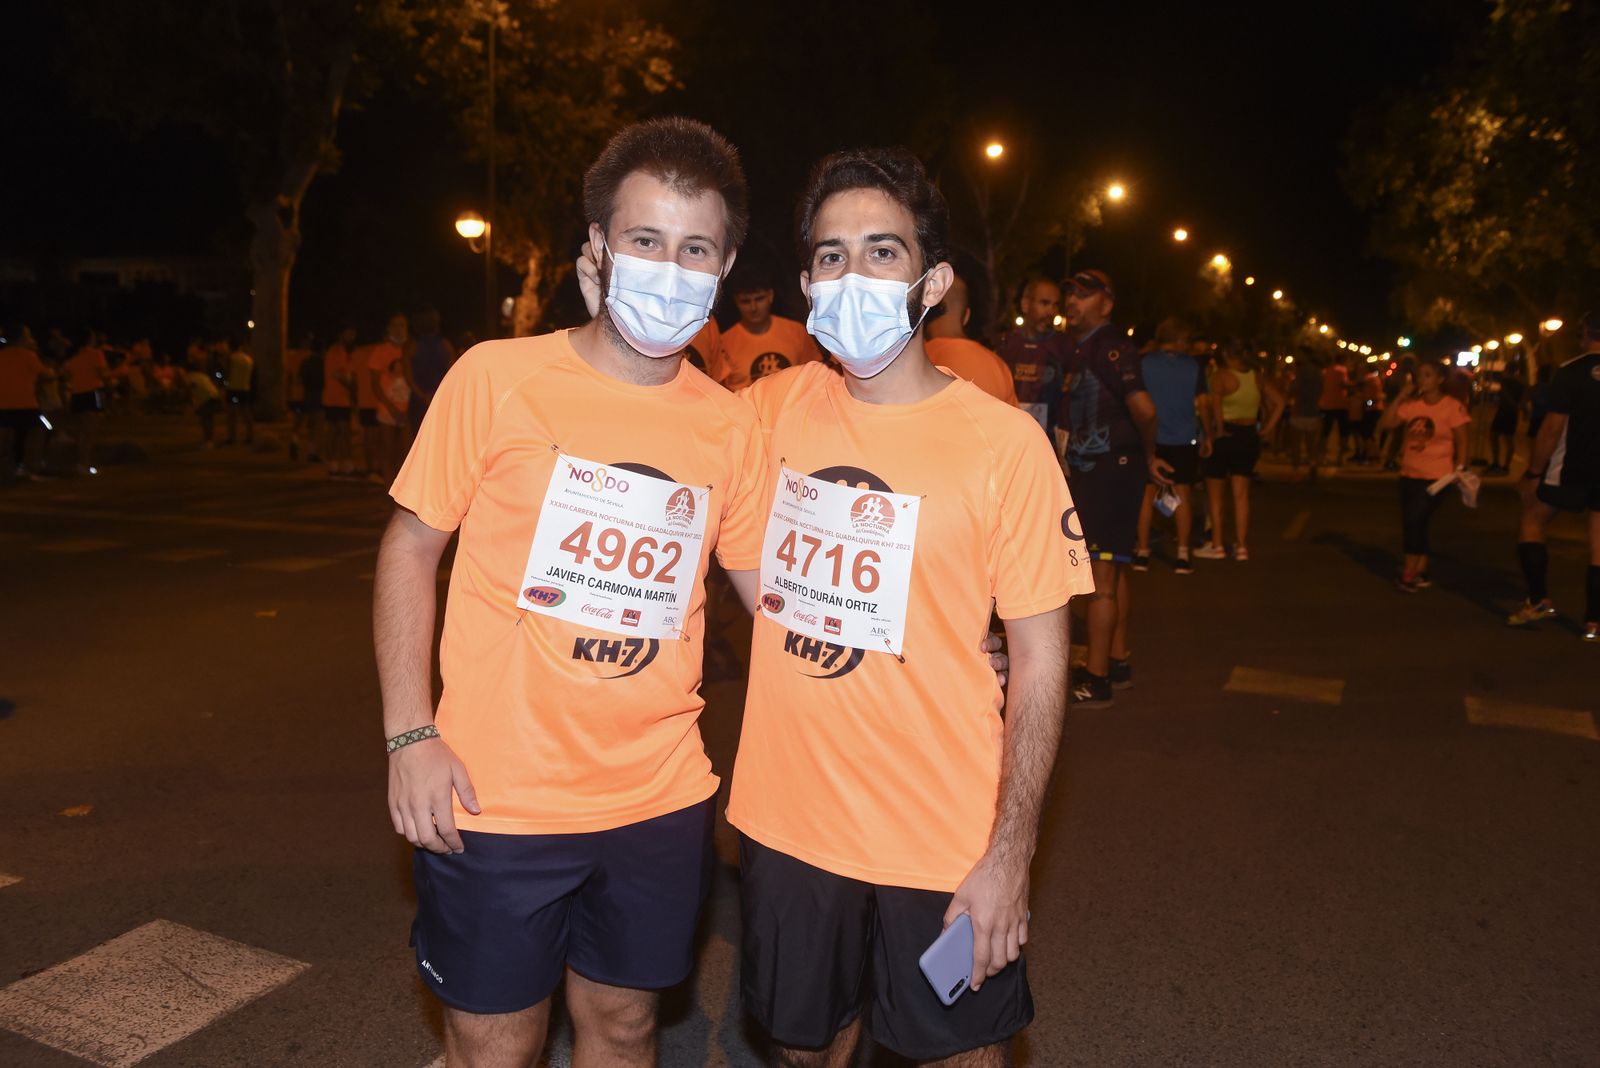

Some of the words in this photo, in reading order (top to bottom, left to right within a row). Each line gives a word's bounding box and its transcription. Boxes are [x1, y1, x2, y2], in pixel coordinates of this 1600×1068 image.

[549, 499, 569, 510] XXXIII
[568, 504, 598, 519] CARRERA
[598, 513, 635, 528] NOCTURNA
[635, 523, 646, 531] DEL
[647, 525, 685, 539] GUADALQUIVIR
[800, 522, 824, 535] NOCTURNA
[824, 529, 835, 538] DEL
[835, 532, 880, 546] GUADALQUIVIR
[880, 540, 895, 549] KH7
[860, 521, 891, 535] NOCTURNA
[559, 520, 682, 585] 4962
[776, 529, 882, 594] 4716
[545, 566, 586, 585] JAVIER
[587, 577, 642, 599] CARMONA
[644, 589, 677, 603] MARTÍN
[774, 575, 808, 597] ALBERTO
[809, 589, 844, 607] DURÁN
[845, 598, 878, 614] ORTIZ
[663, 616, 678, 625] ABC
[870, 626, 890, 635] ABC
